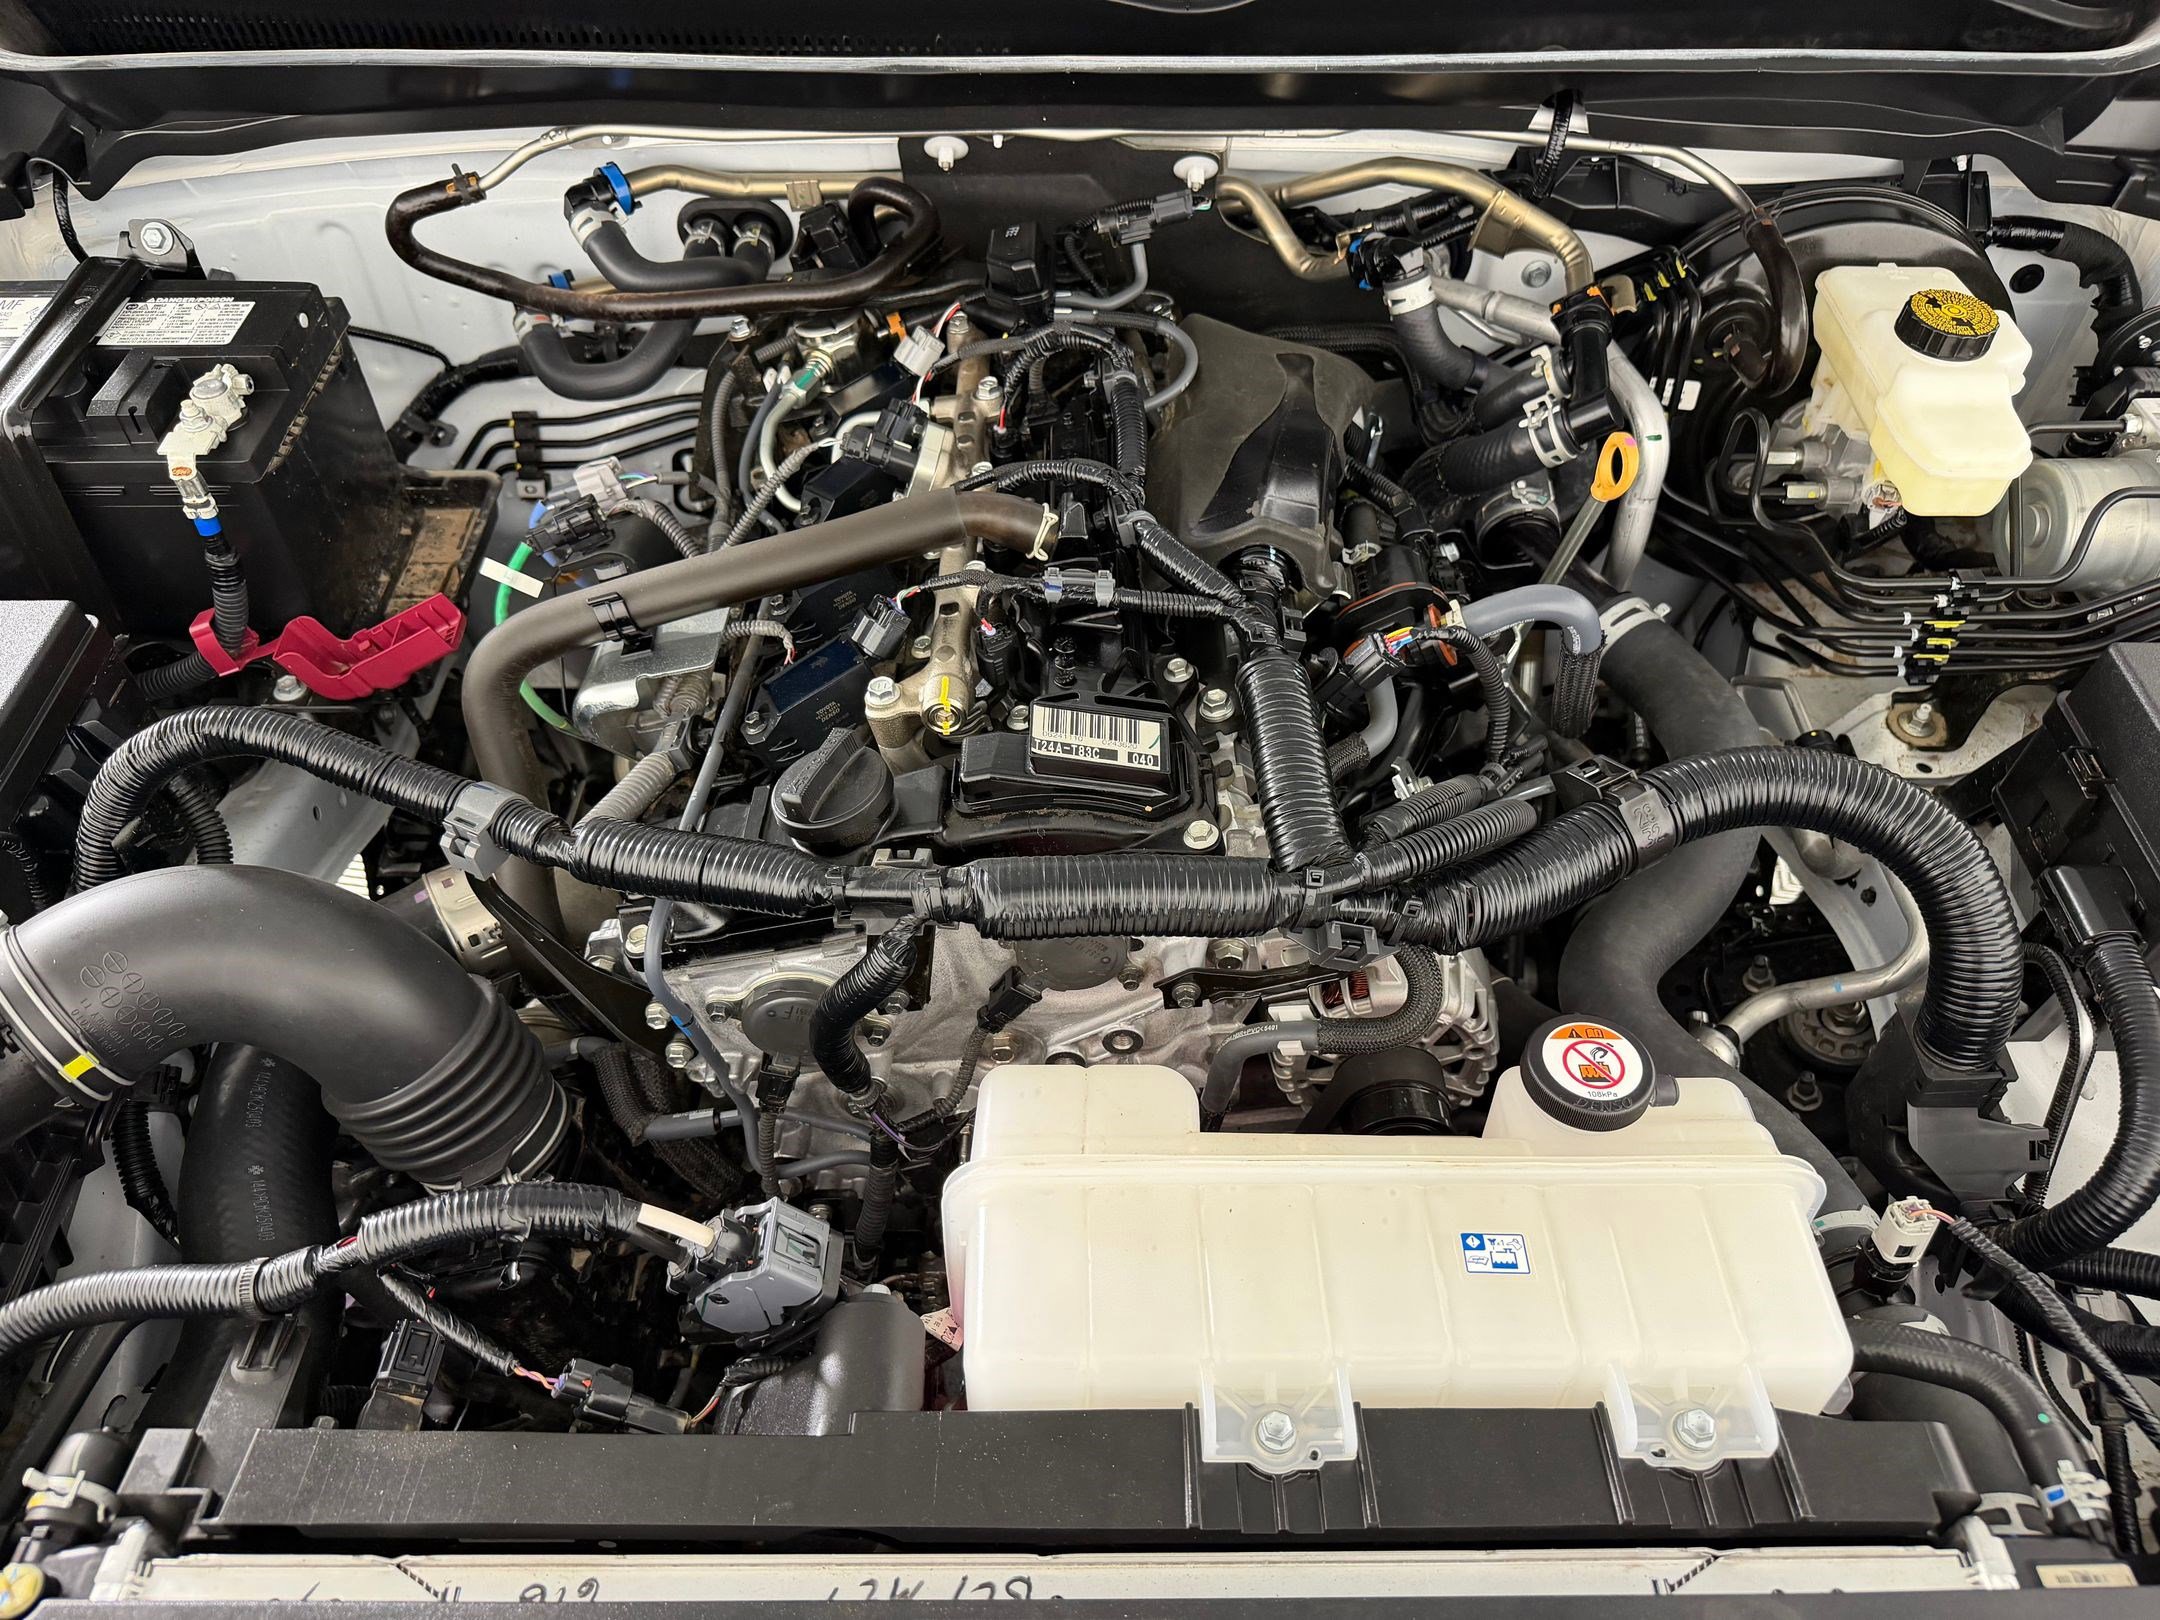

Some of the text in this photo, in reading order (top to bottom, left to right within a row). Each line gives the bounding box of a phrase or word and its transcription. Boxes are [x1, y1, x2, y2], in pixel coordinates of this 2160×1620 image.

[1034, 739, 1154, 766] T24A-T83C 040
[1587, 1089, 1618, 1098] 108kPa
[1573, 1096, 1633, 1113] DENSO
